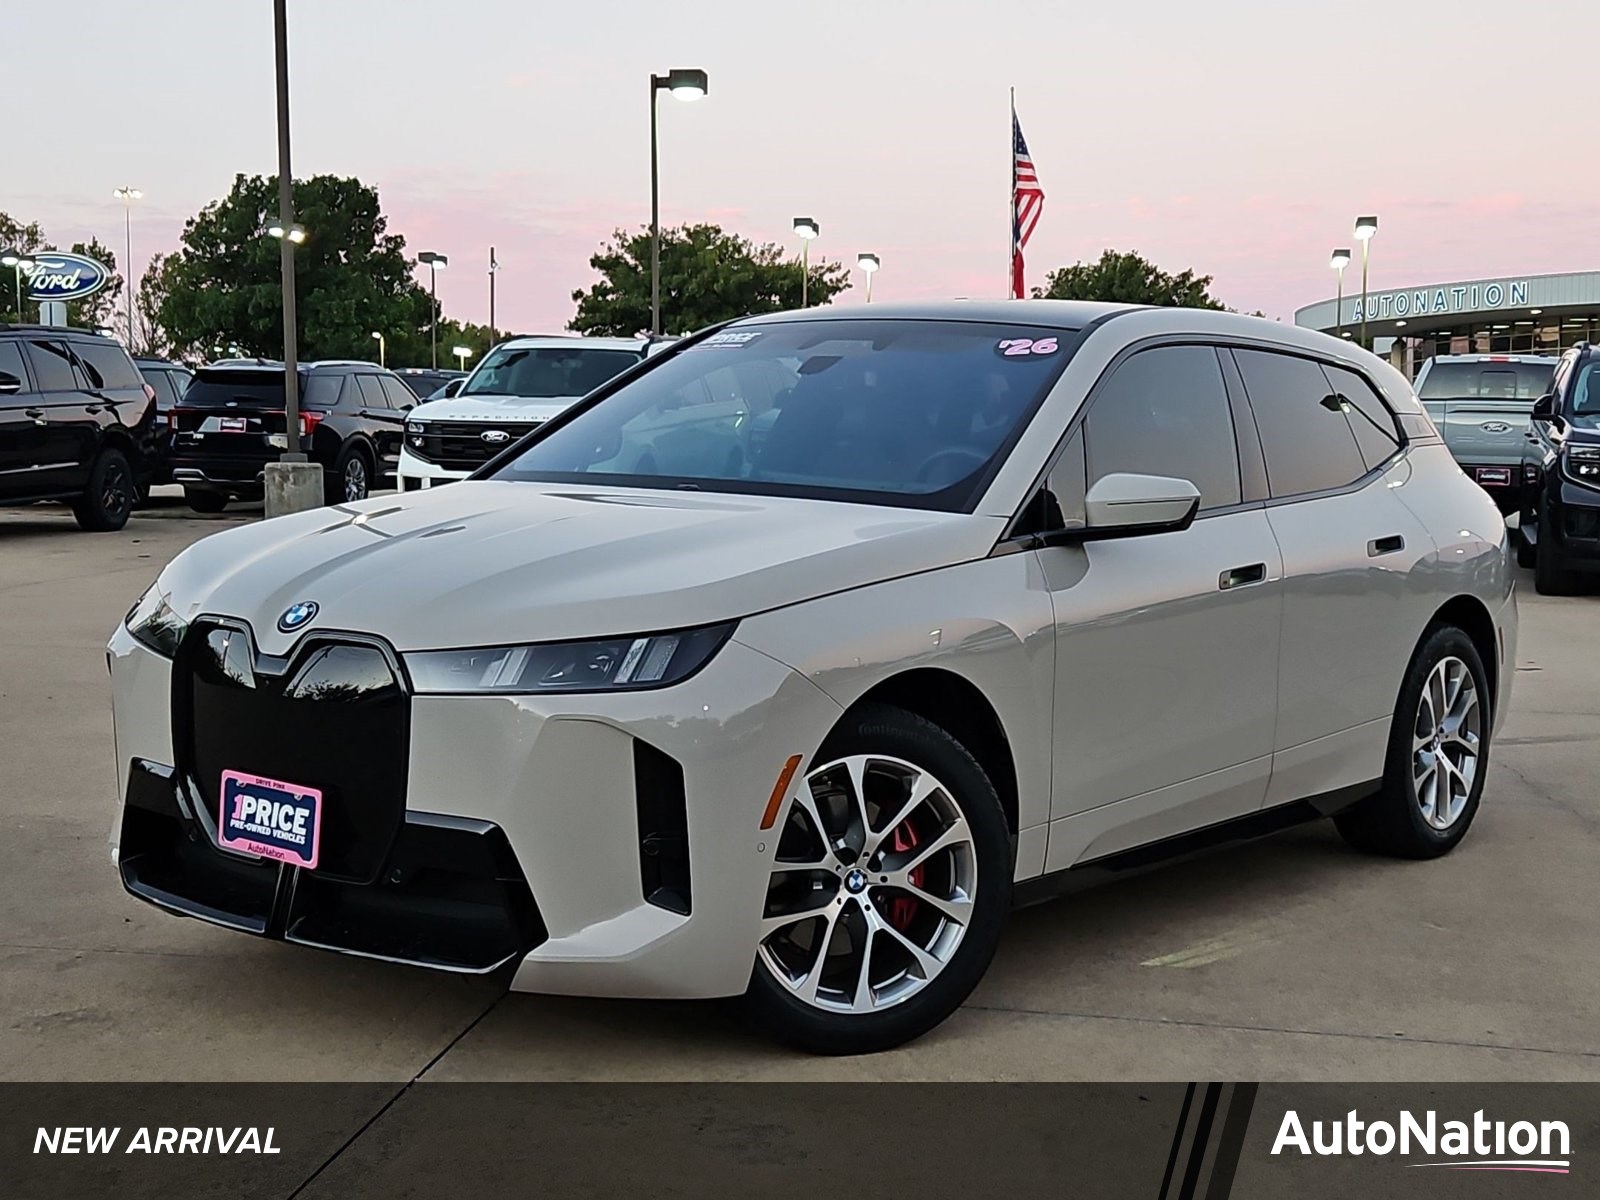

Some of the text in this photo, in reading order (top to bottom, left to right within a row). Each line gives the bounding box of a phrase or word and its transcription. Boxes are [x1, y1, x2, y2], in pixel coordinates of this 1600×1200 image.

[28, 261, 81, 290] Ford
[1352, 281, 1528, 321] AUTONATION
[255, 778, 285, 790] DRIVE PINK
[230, 819, 306, 845] PRE-OWNED VEHICLES
[247, 842, 285, 860] AutoNation
